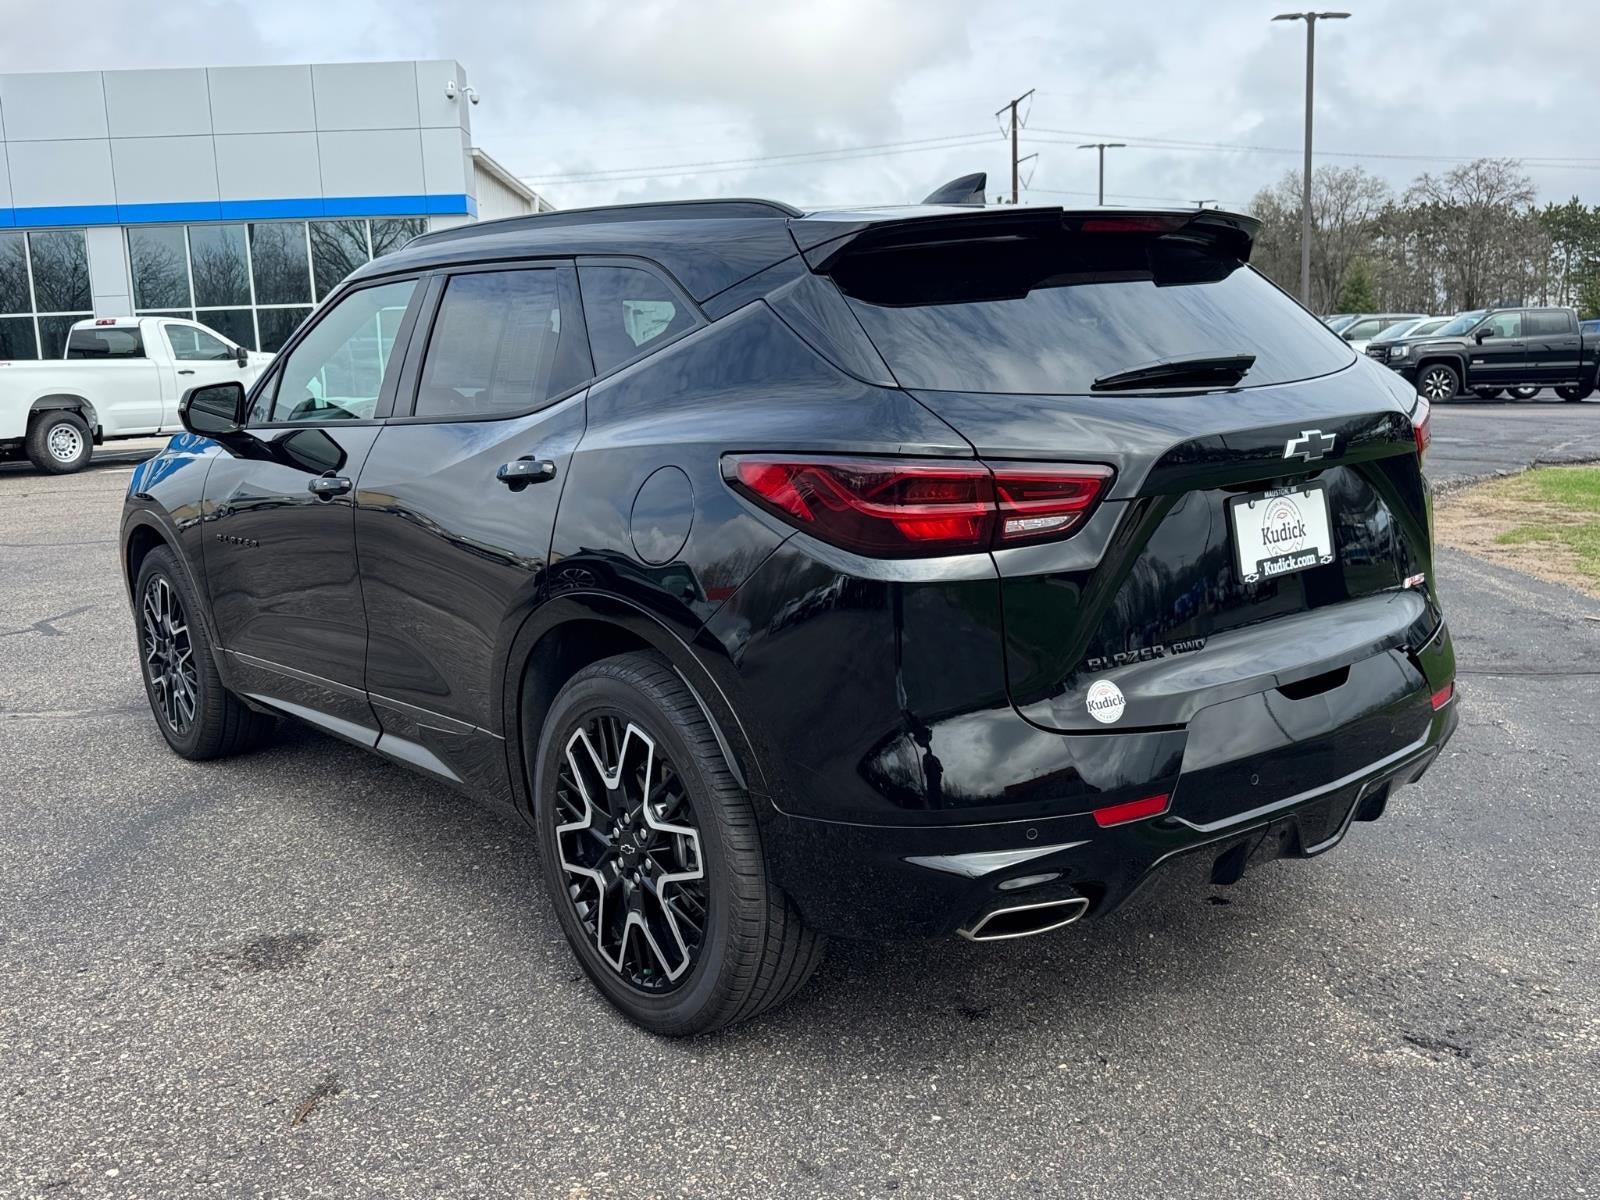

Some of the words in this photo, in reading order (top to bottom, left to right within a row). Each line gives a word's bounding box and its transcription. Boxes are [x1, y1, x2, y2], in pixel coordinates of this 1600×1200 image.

[1261, 519, 1307, 546] Kudick
[1263, 553, 1317, 576] Kudick.com
[1087, 644, 1166, 673] BLAZER
[1087, 693, 1126, 712] Kudick
